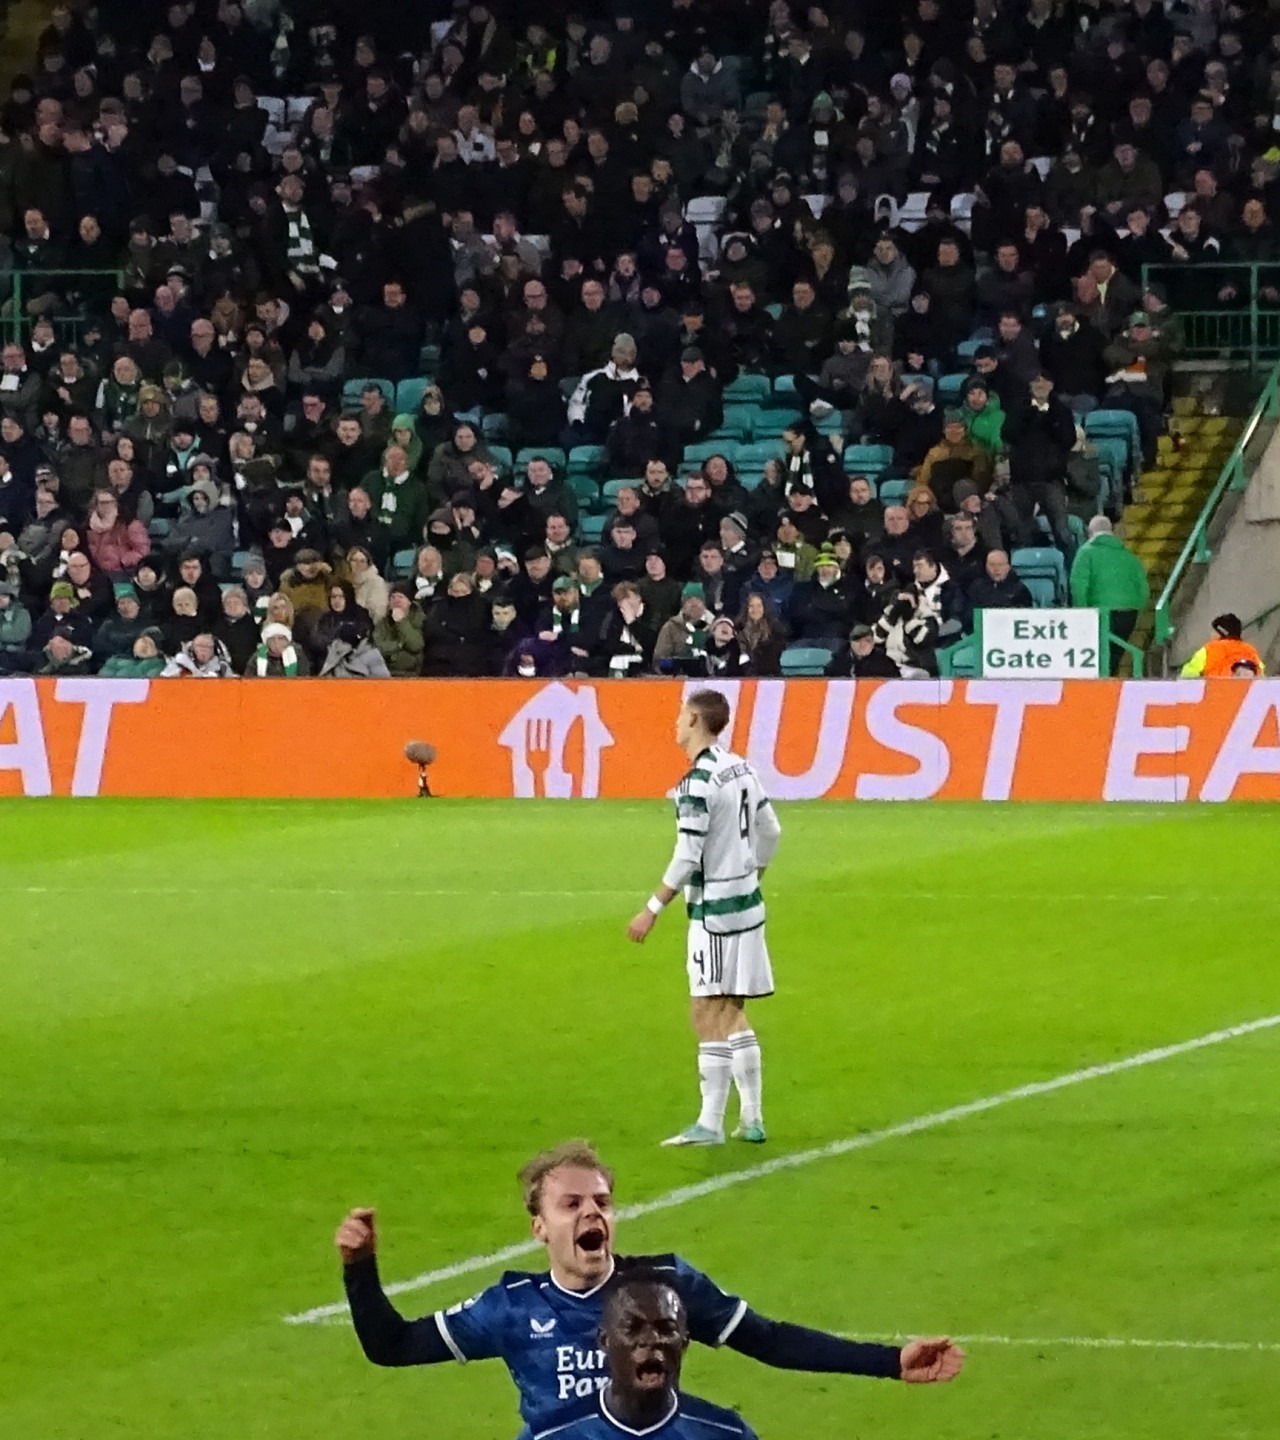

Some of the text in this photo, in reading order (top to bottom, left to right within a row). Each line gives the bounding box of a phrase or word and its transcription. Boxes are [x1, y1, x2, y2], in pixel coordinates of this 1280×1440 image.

[1013, 620, 1068, 640] Exit
[986, 648, 1096, 669] Gate 12
[692, 949, 705, 976] 4
[556, 1346, 607, 1373] Eur
[557, 1374, 613, 1400] Par
